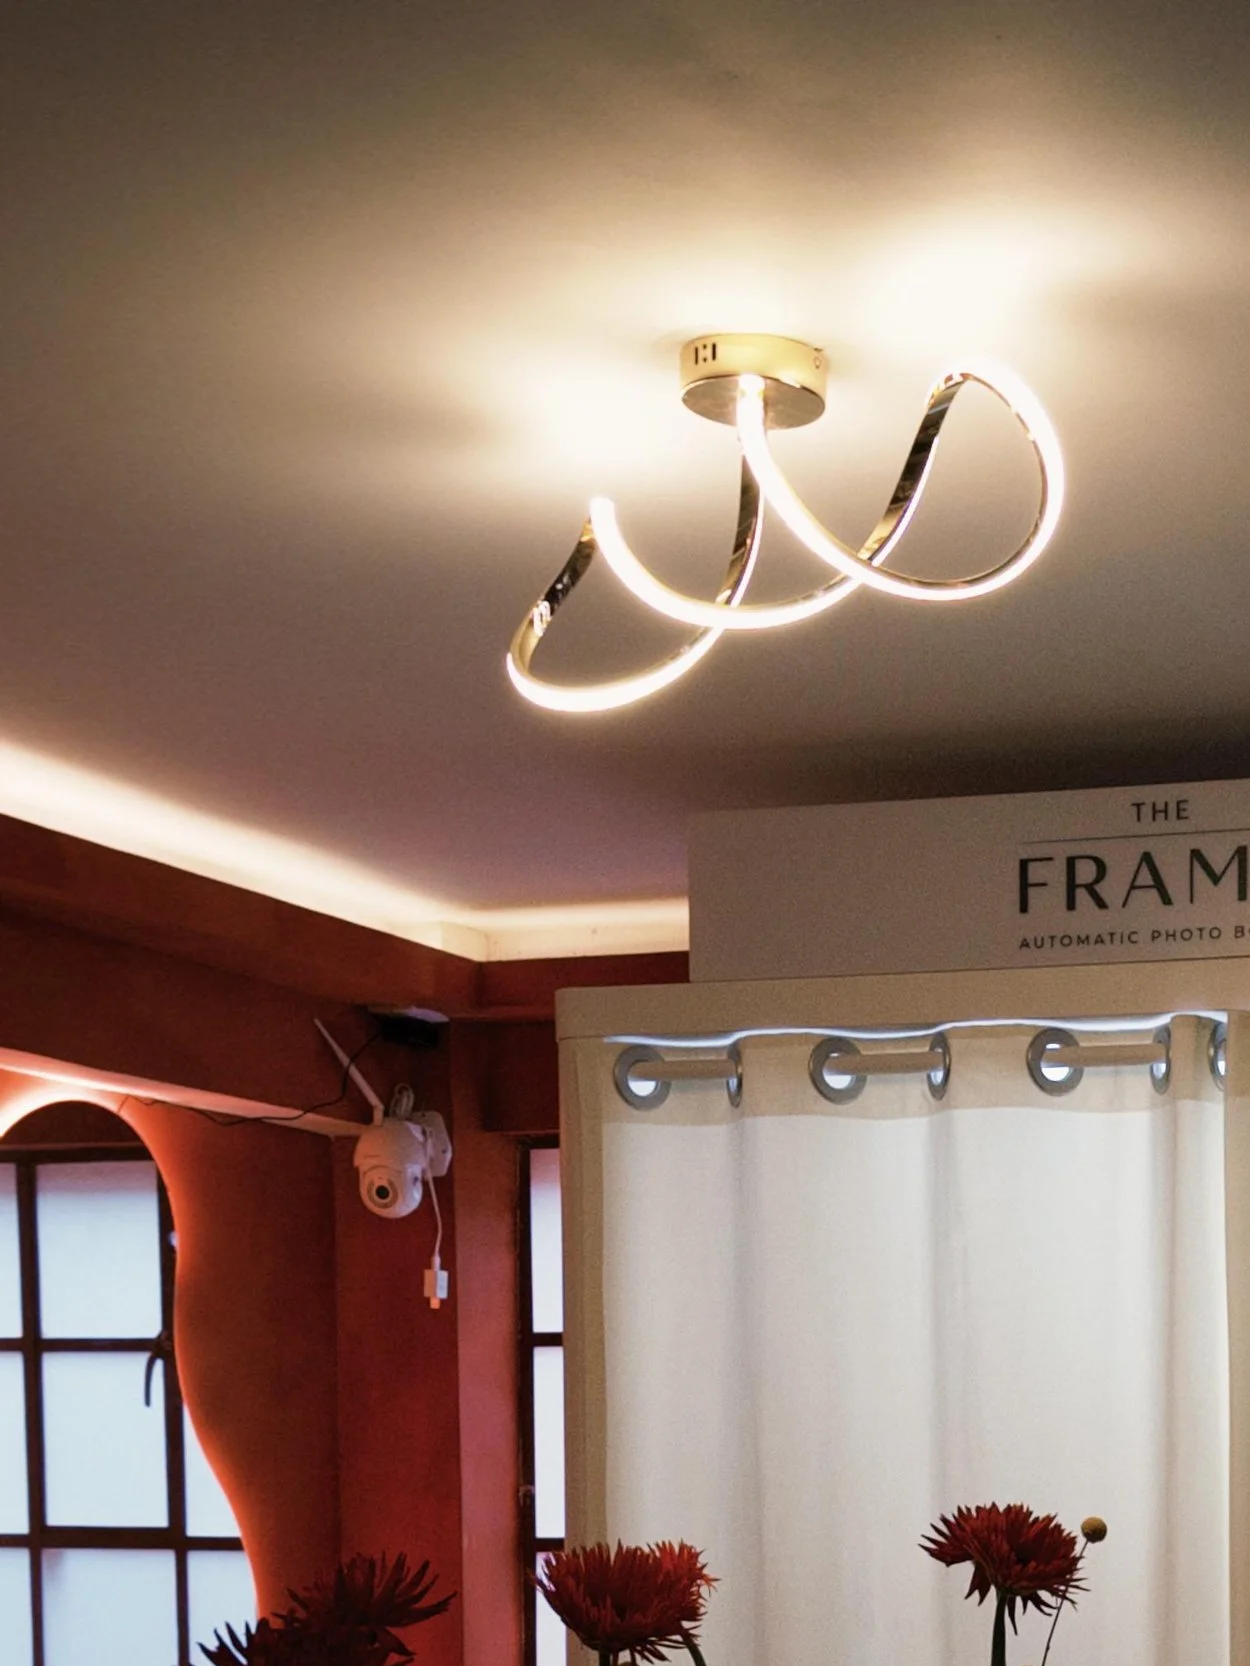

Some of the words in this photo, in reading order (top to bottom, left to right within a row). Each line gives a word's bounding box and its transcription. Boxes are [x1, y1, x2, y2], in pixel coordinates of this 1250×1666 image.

[1131, 800, 1190, 822] THE
[1019, 930, 1139, 949] AUTOMATIC
[1151, 926, 1222, 943] PHOTO
